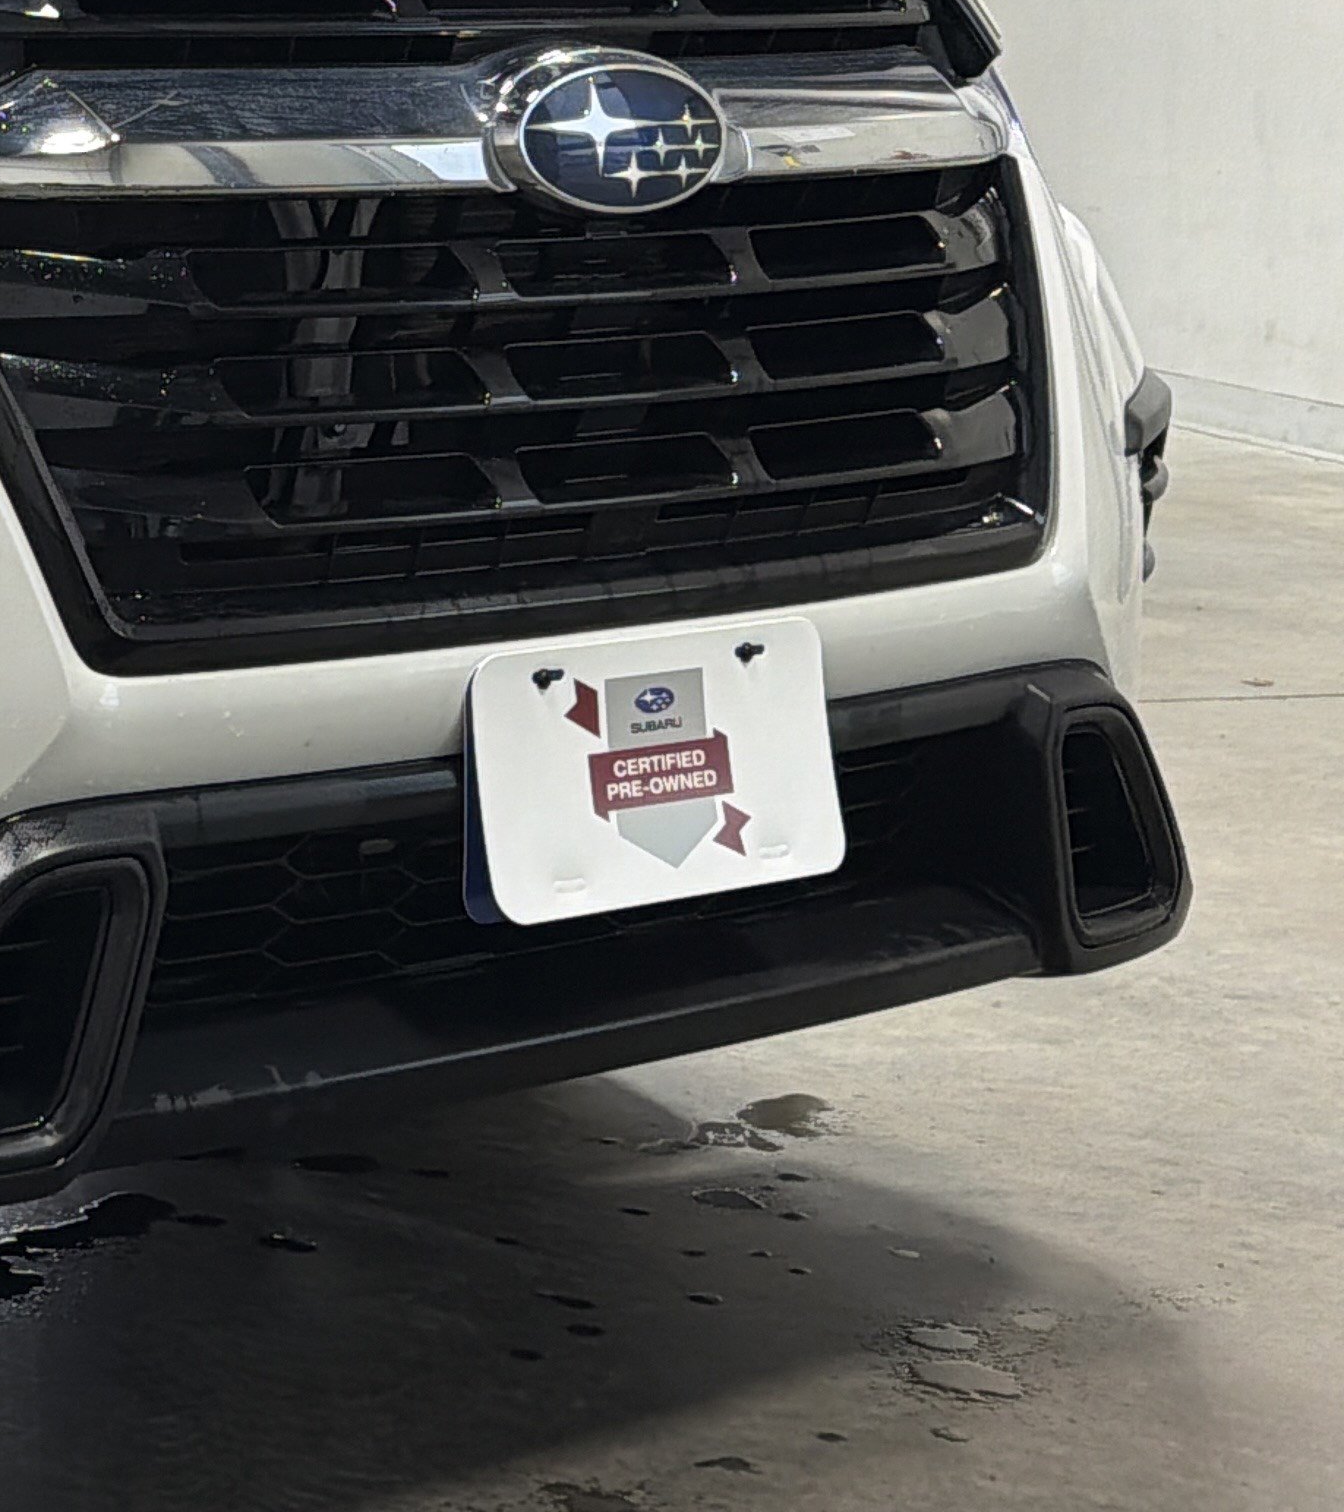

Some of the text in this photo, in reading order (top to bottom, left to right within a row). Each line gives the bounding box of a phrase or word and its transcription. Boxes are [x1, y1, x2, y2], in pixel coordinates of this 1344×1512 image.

[630, 718, 682, 734] SUBARU
[613, 749, 706, 777] CERTIFIED
[606, 770, 717, 801] PRE-OWNED
